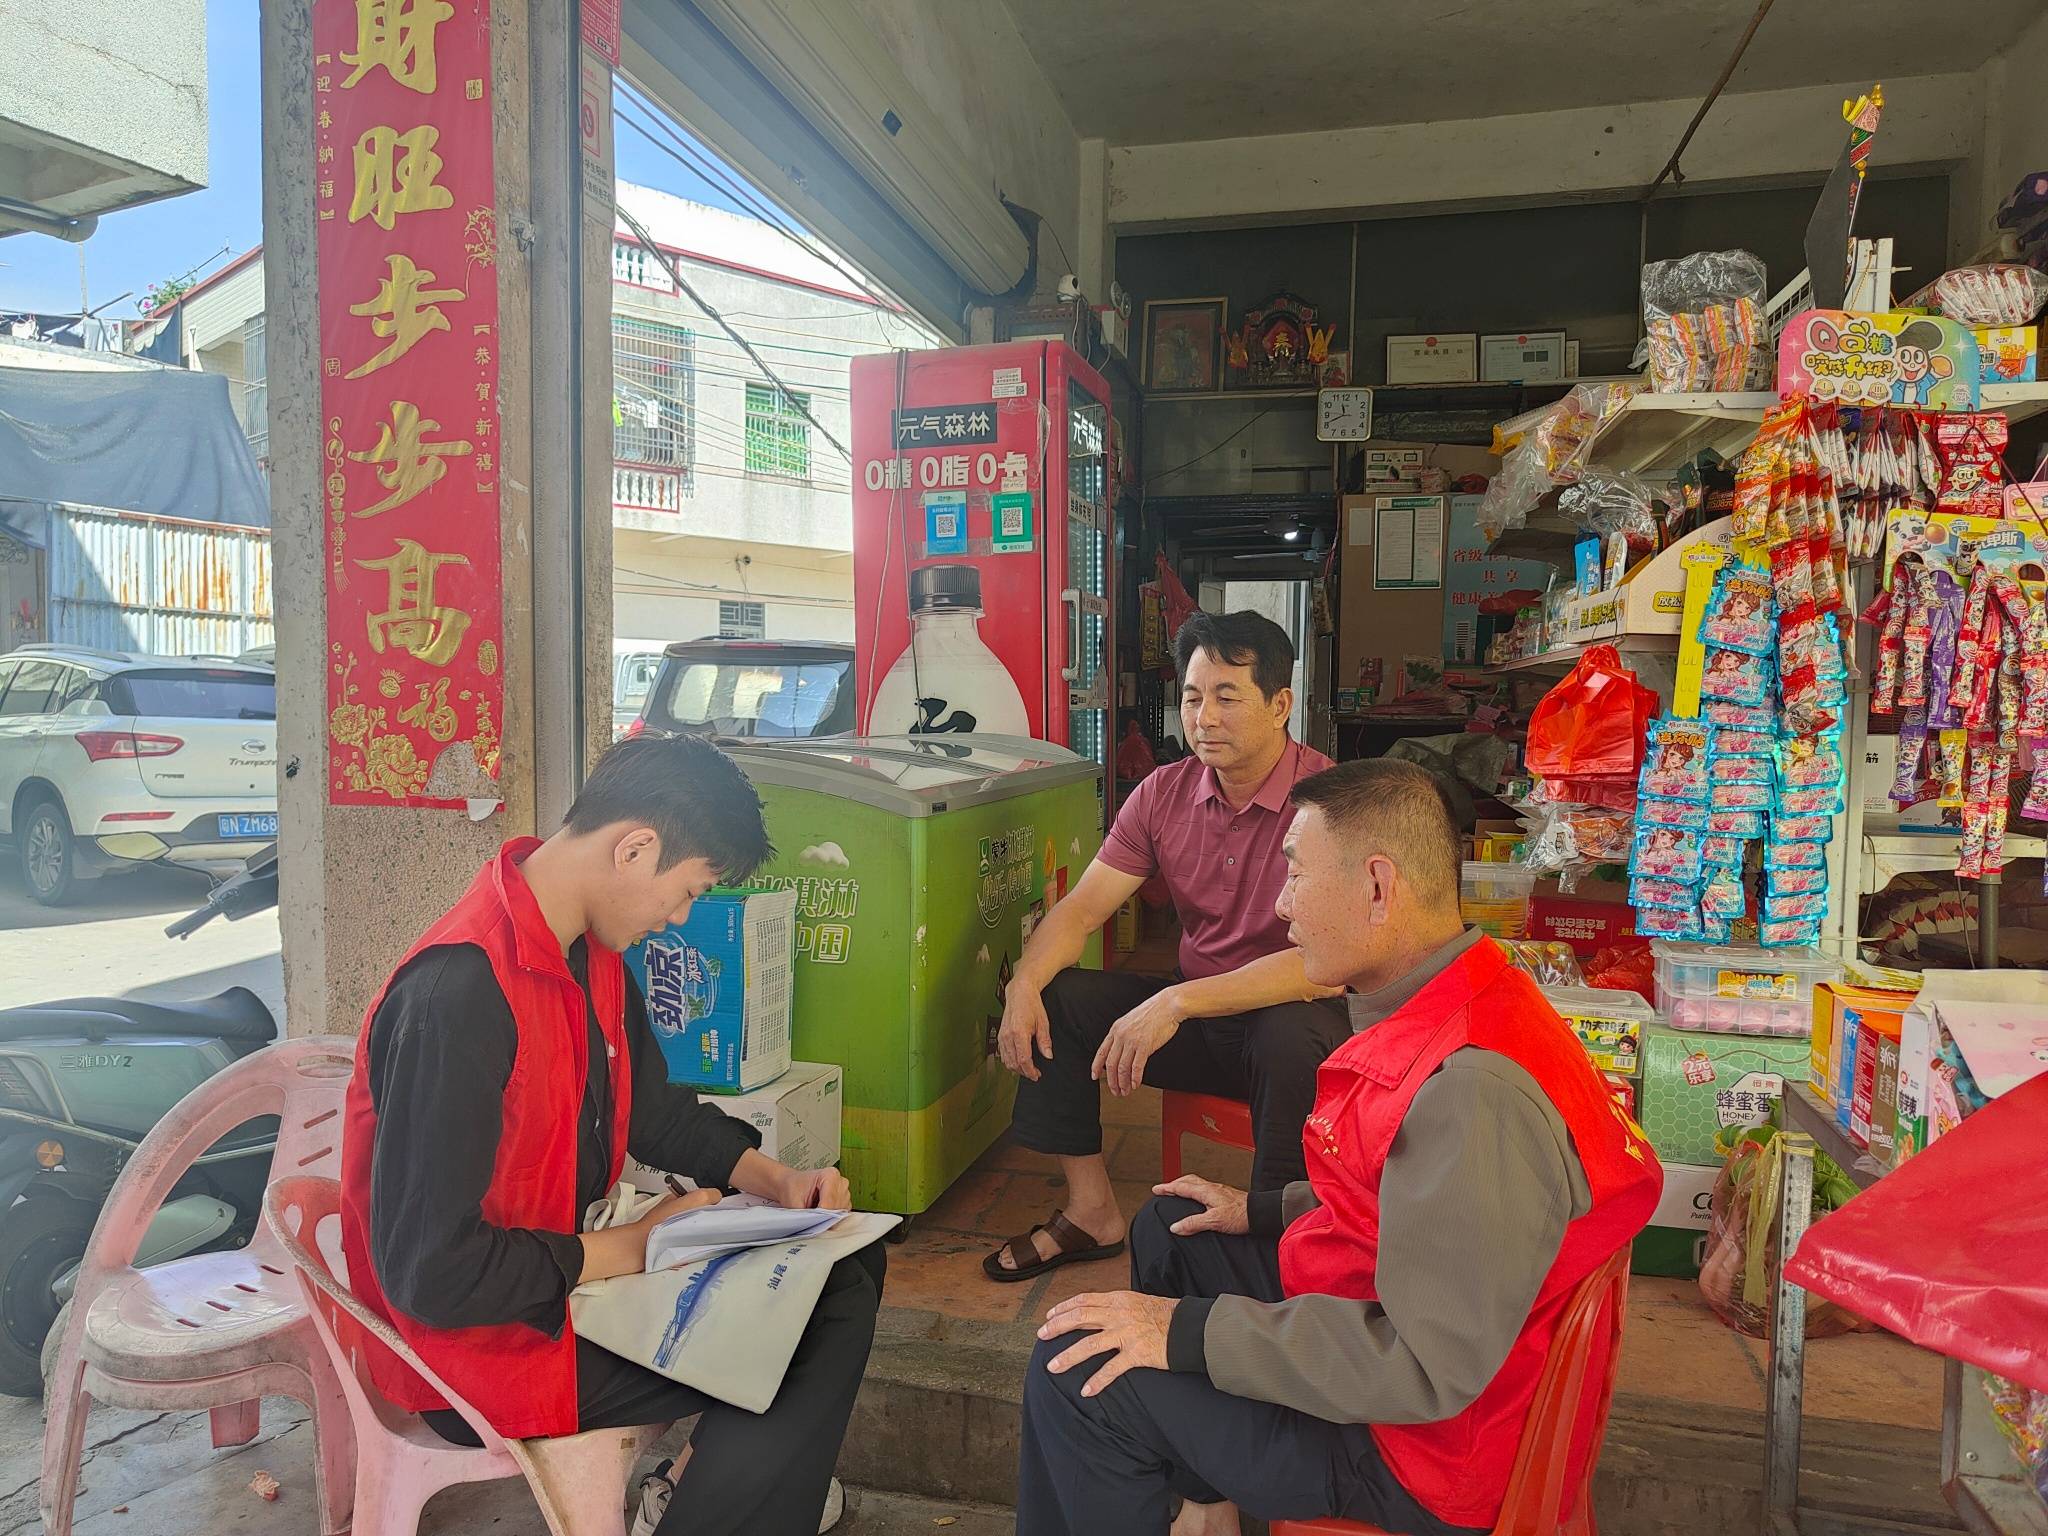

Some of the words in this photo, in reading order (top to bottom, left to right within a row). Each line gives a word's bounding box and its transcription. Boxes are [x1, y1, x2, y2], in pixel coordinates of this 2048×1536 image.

[1810, 320, 1894, 355] QQ糖
[1333, 394, 1340, 402] 11
[899, 411, 991, 443] 元气森林
[920, 453, 970, 488] 0脂
[686, 946, 705, 984] 冰红茶
[644, 940, 685, 1034] 劲凉
[1683, 1059, 1711, 1074] 2元
[1688, 1070, 1715, 1085] 乐享
[1716, 1089, 1783, 1112] 蜂蜜番
[1722, 1111, 1757, 1121] HONEY
